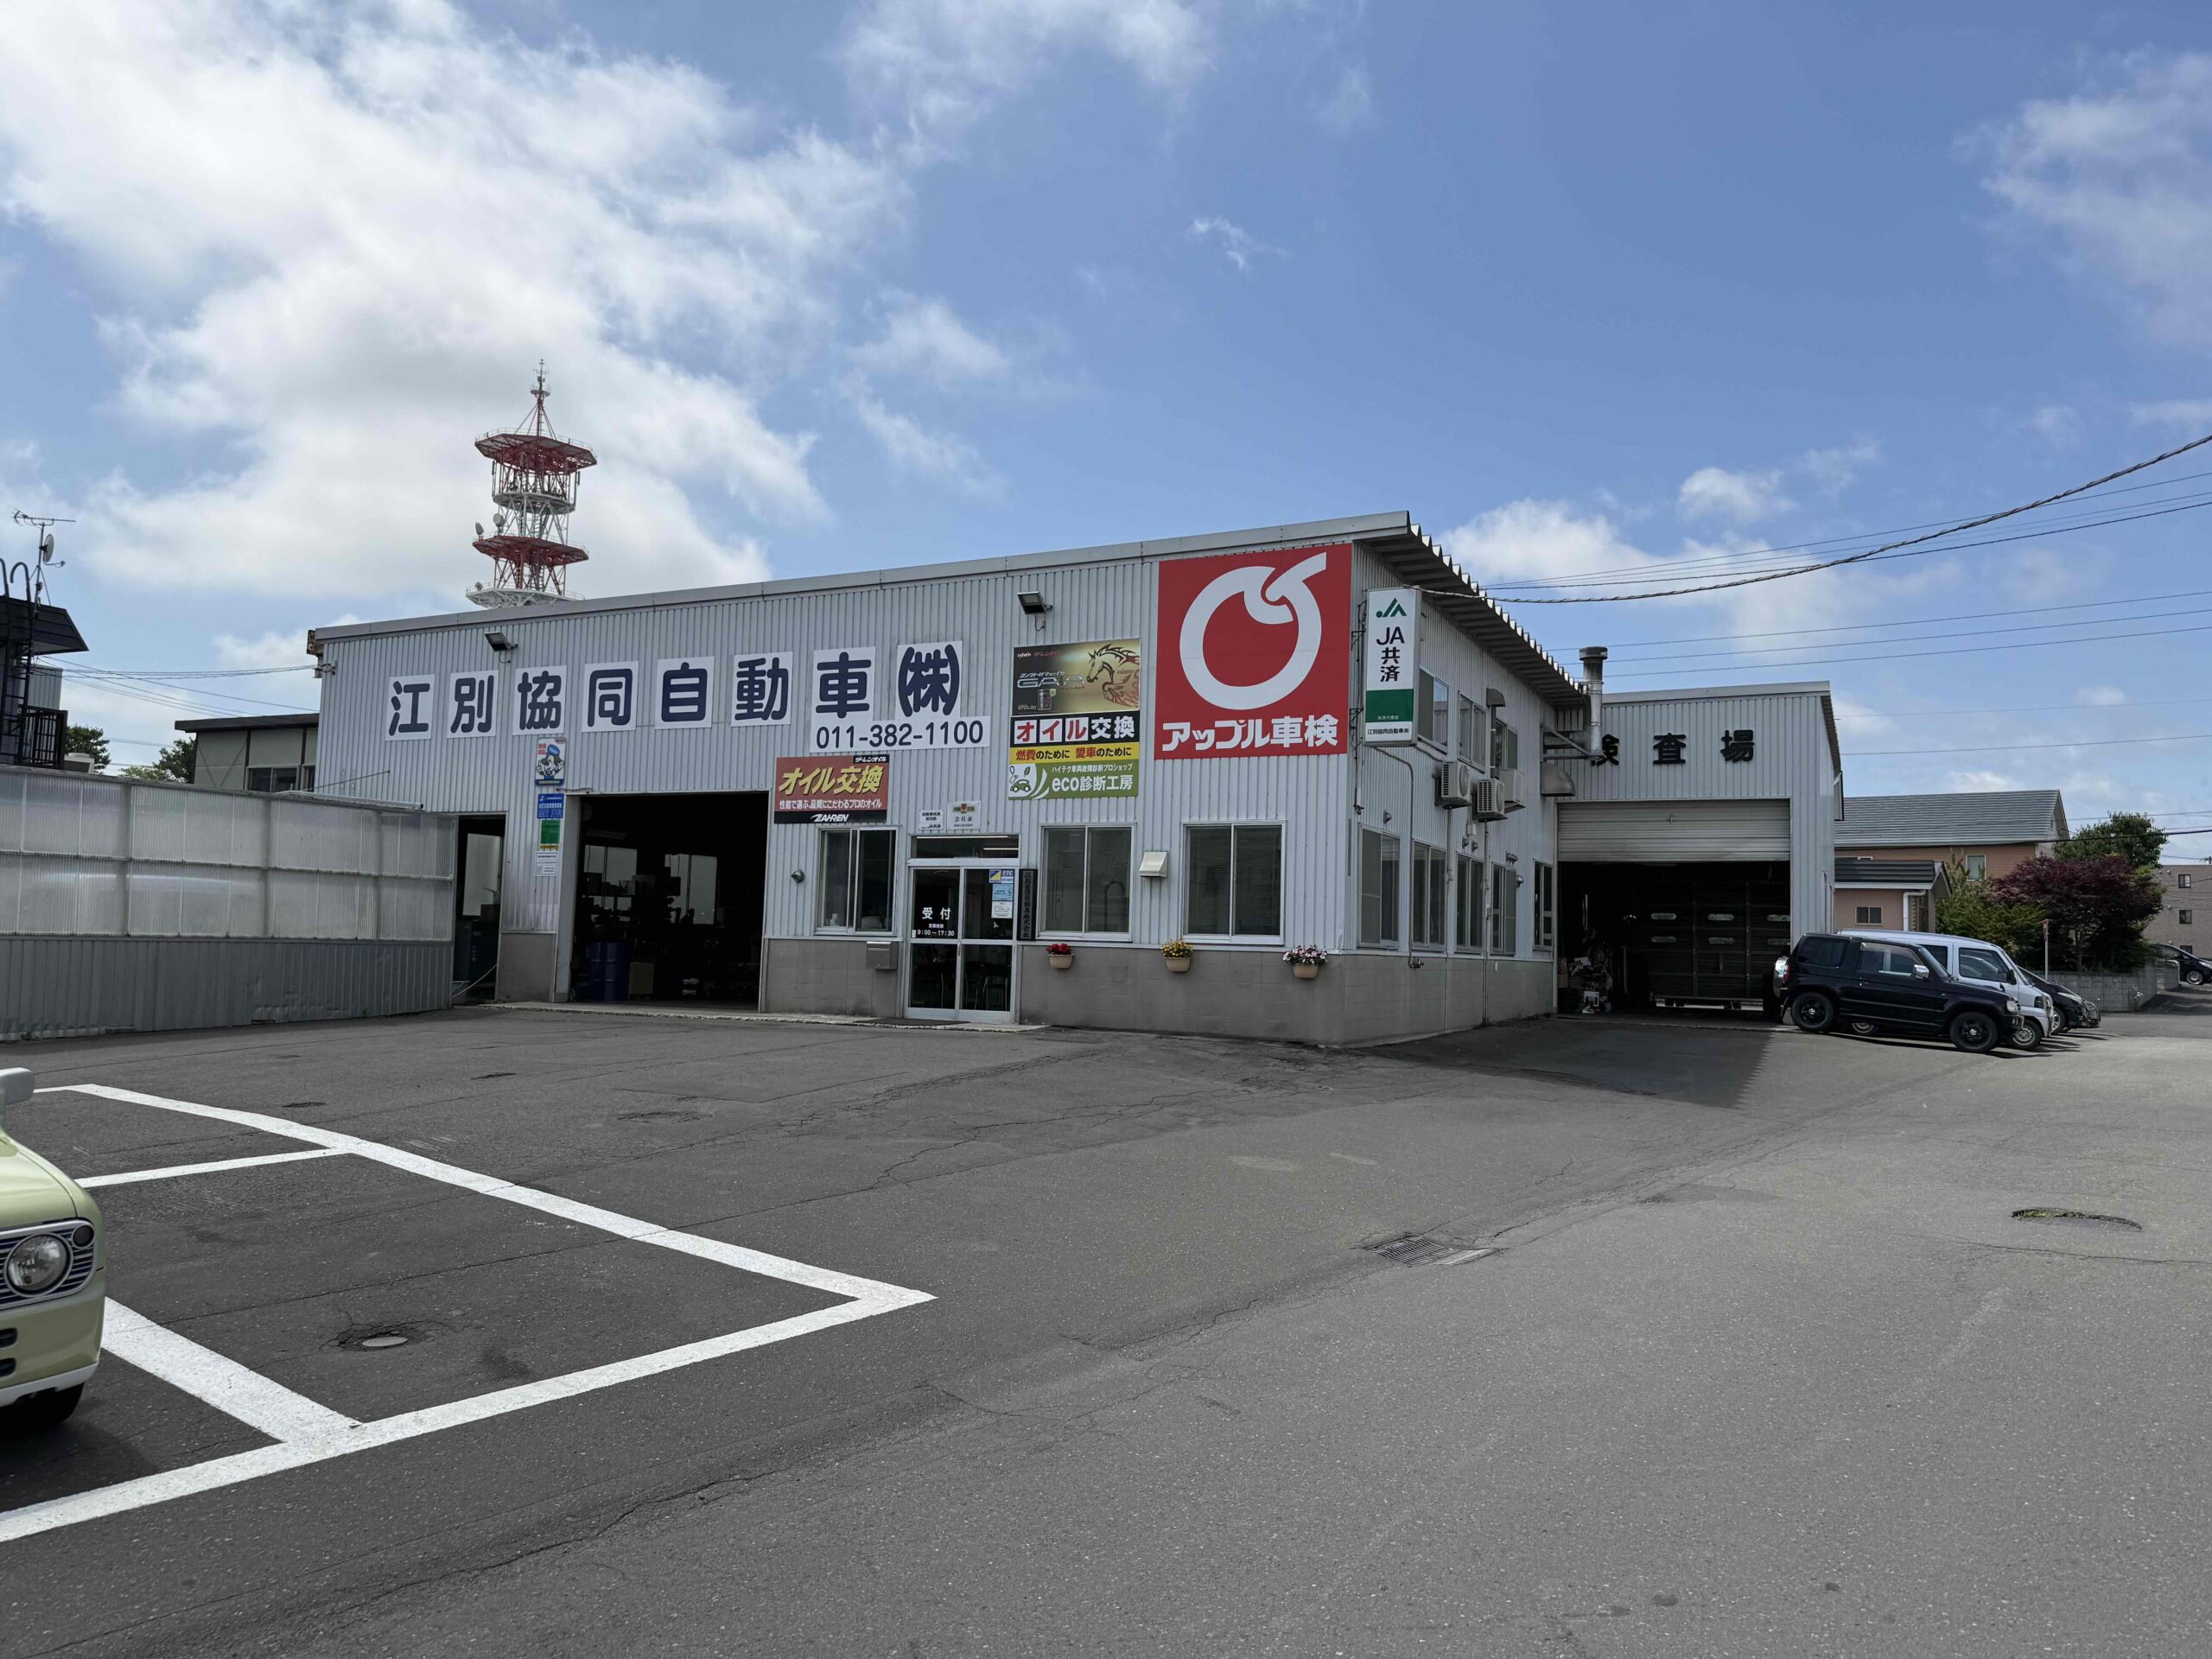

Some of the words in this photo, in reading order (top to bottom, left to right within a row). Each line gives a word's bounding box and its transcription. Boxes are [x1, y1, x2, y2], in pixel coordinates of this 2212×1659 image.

[1376, 626, 1405, 682] JA共済
[816, 720, 984, 749] 011-382-1100
[1016, 715, 1135, 742] オイル交換
[1161, 714, 1339, 752] アップル車検
[1015, 749, 1071, 761] 燃費のために
[1076, 747, 1132, 759] 愛車のために
[779, 765, 884, 796] オイル交換
[1052, 774, 1134, 792] eco診断工房
[810, 814, 849, 823] ZAHREN
[922, 907, 951, 920] 受付
